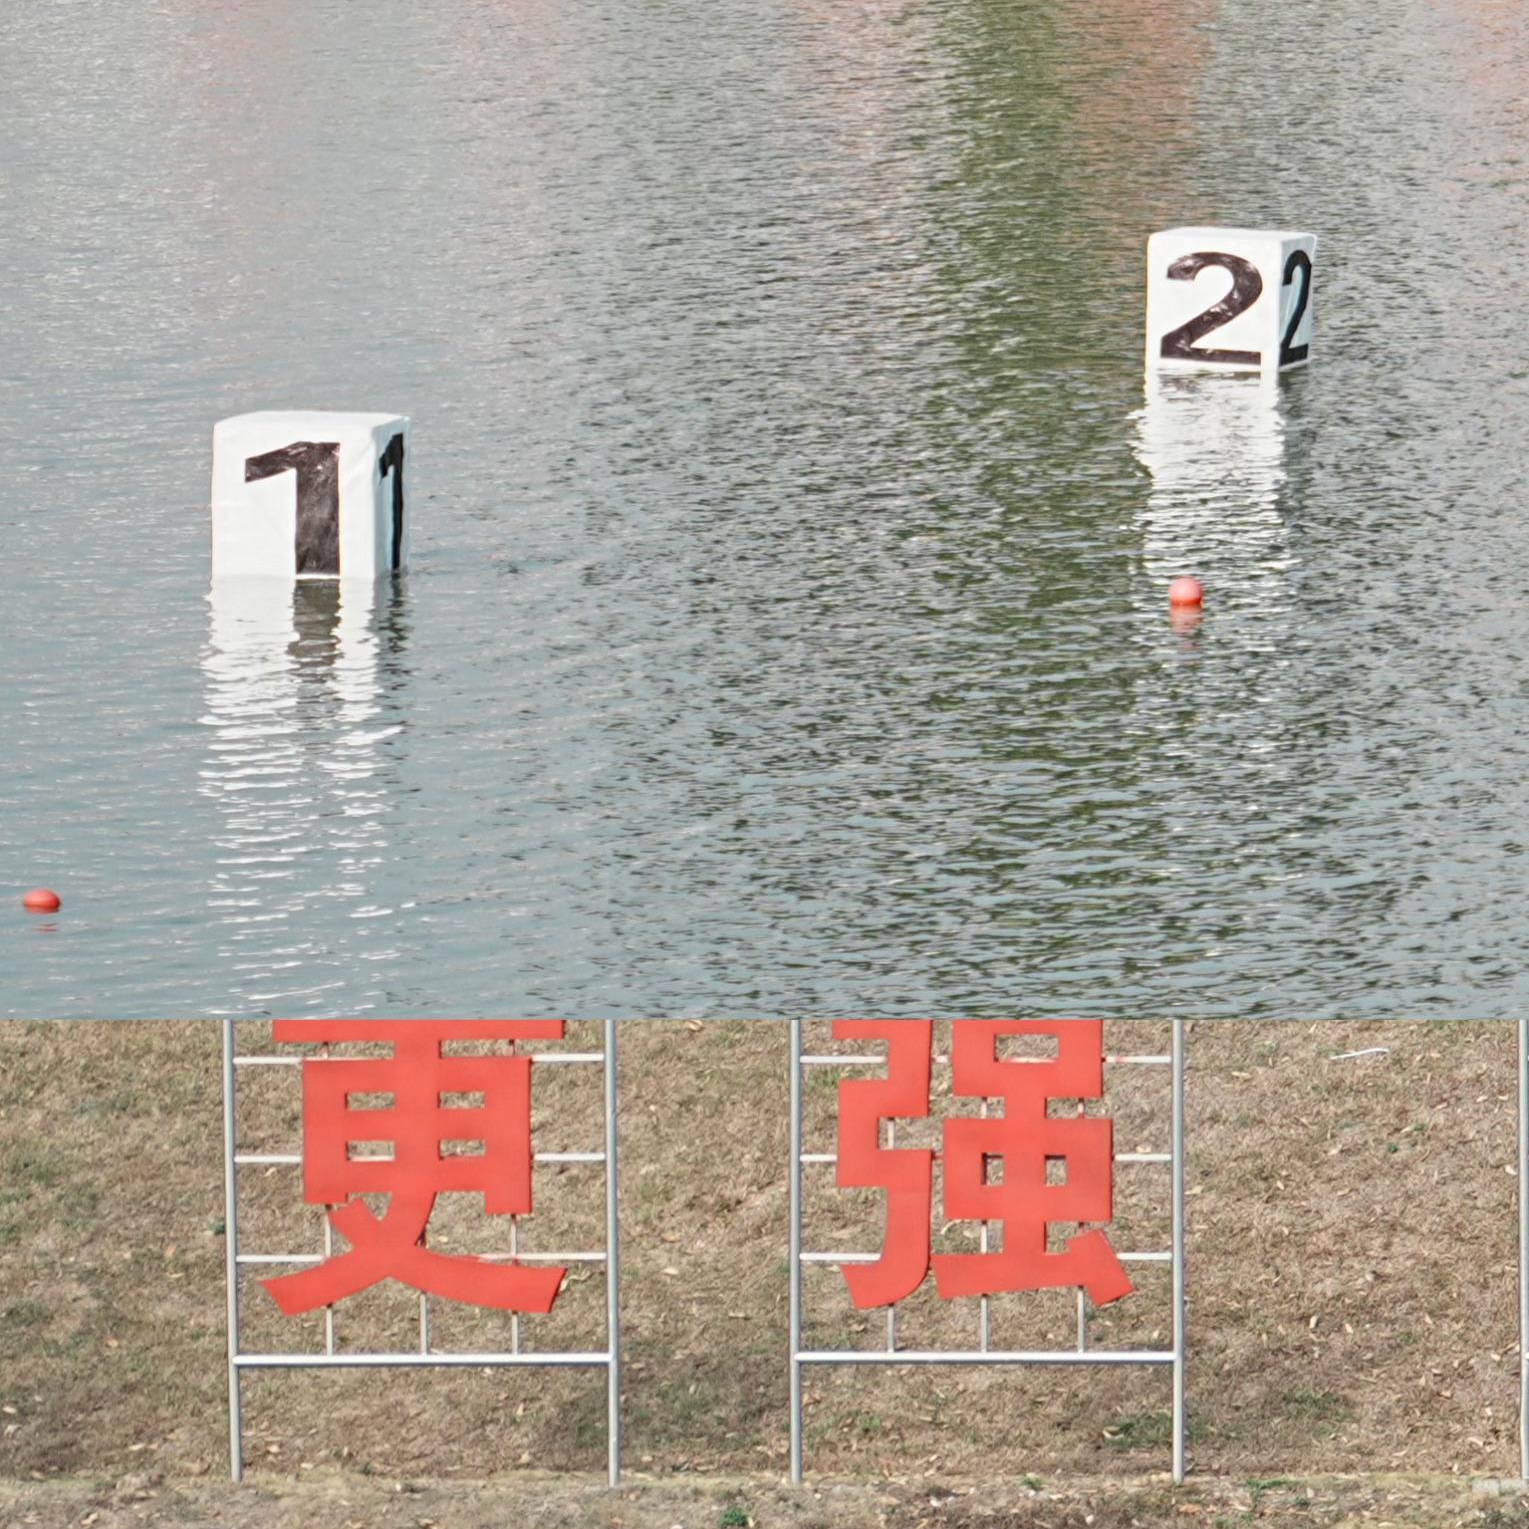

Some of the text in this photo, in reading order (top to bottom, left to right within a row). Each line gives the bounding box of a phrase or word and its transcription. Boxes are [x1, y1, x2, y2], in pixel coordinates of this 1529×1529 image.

[1160, 252, 1263, 364] 2
[1281, 250, 1312, 362] 2
[245, 441, 340, 575] 1
[379, 432, 404, 570] 1
[262, 1020, 1134, 1316] 更强
